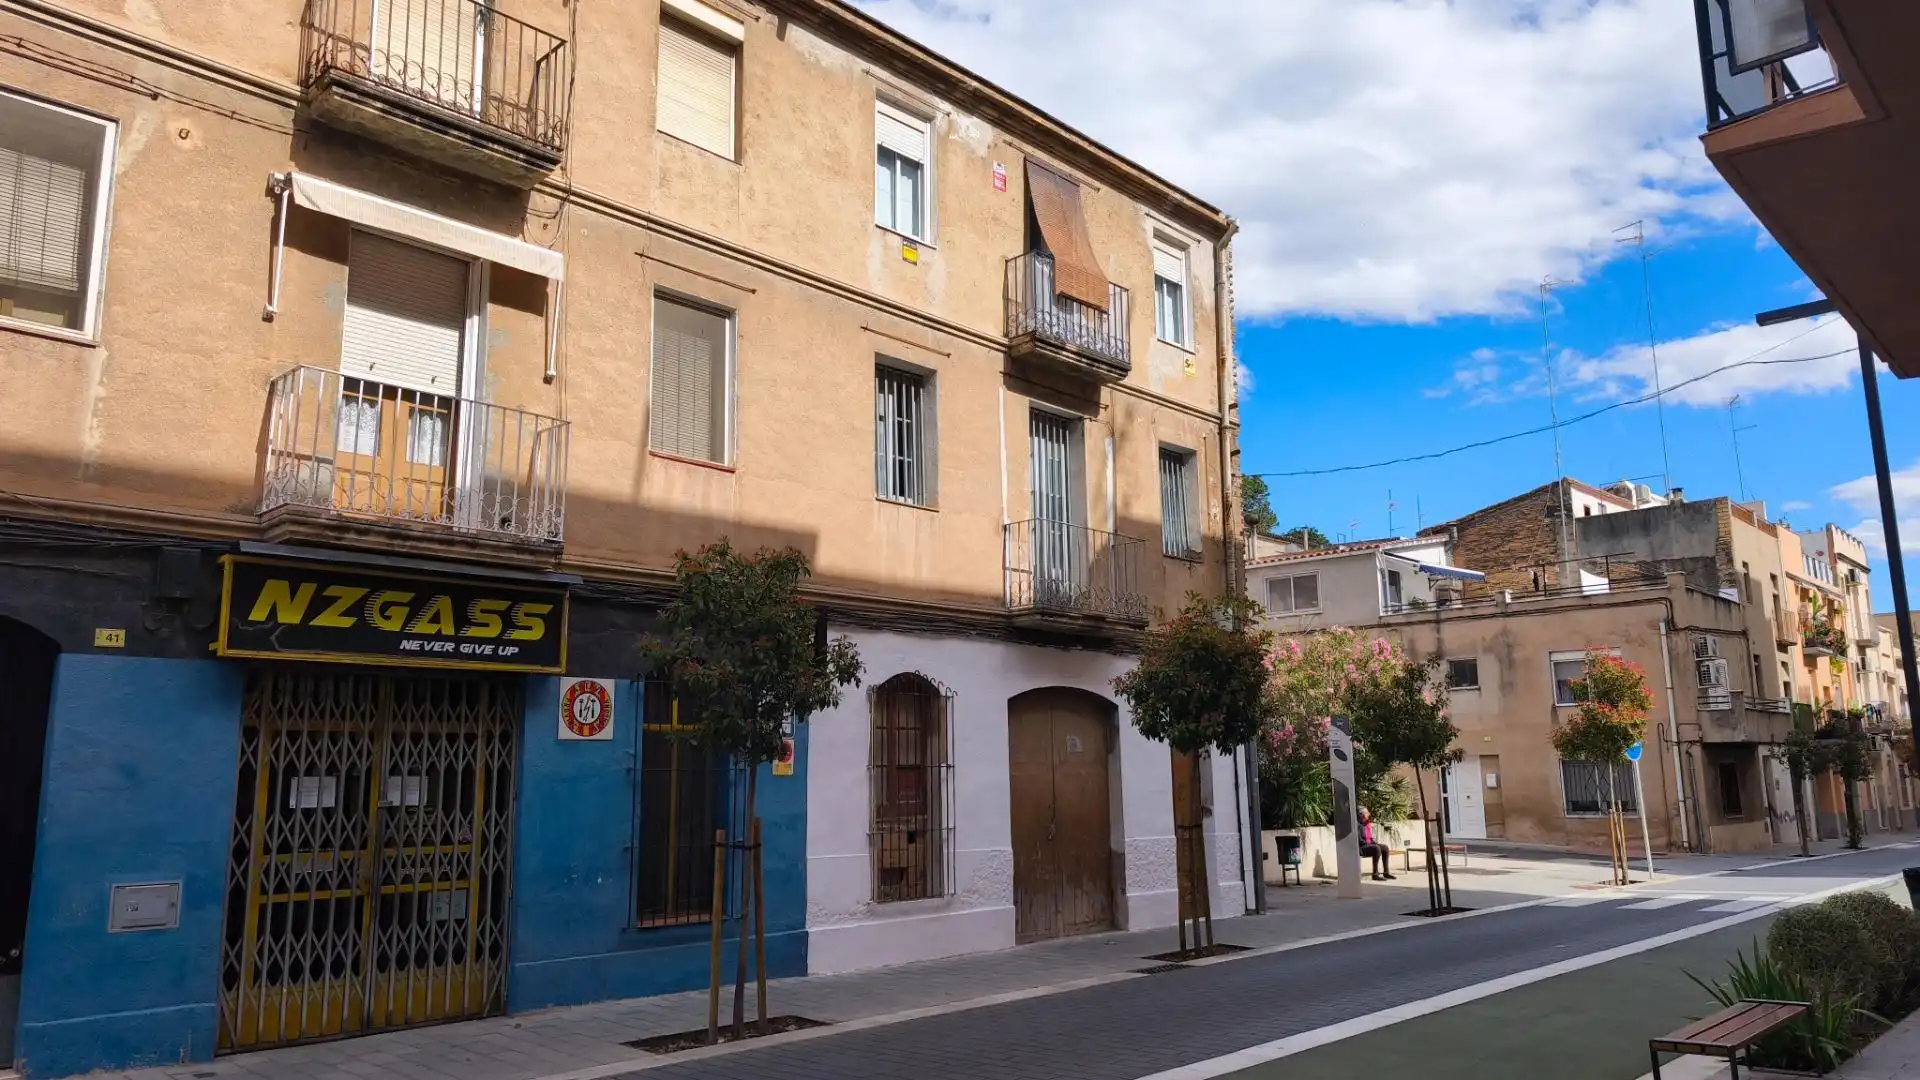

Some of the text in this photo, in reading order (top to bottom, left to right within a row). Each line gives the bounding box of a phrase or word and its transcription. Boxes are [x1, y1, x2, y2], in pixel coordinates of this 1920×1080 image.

[248, 579, 554, 640] NZGASS
[105, 633, 119, 642] 41
[400, 639, 519, 657] NEVER GIVE UP
